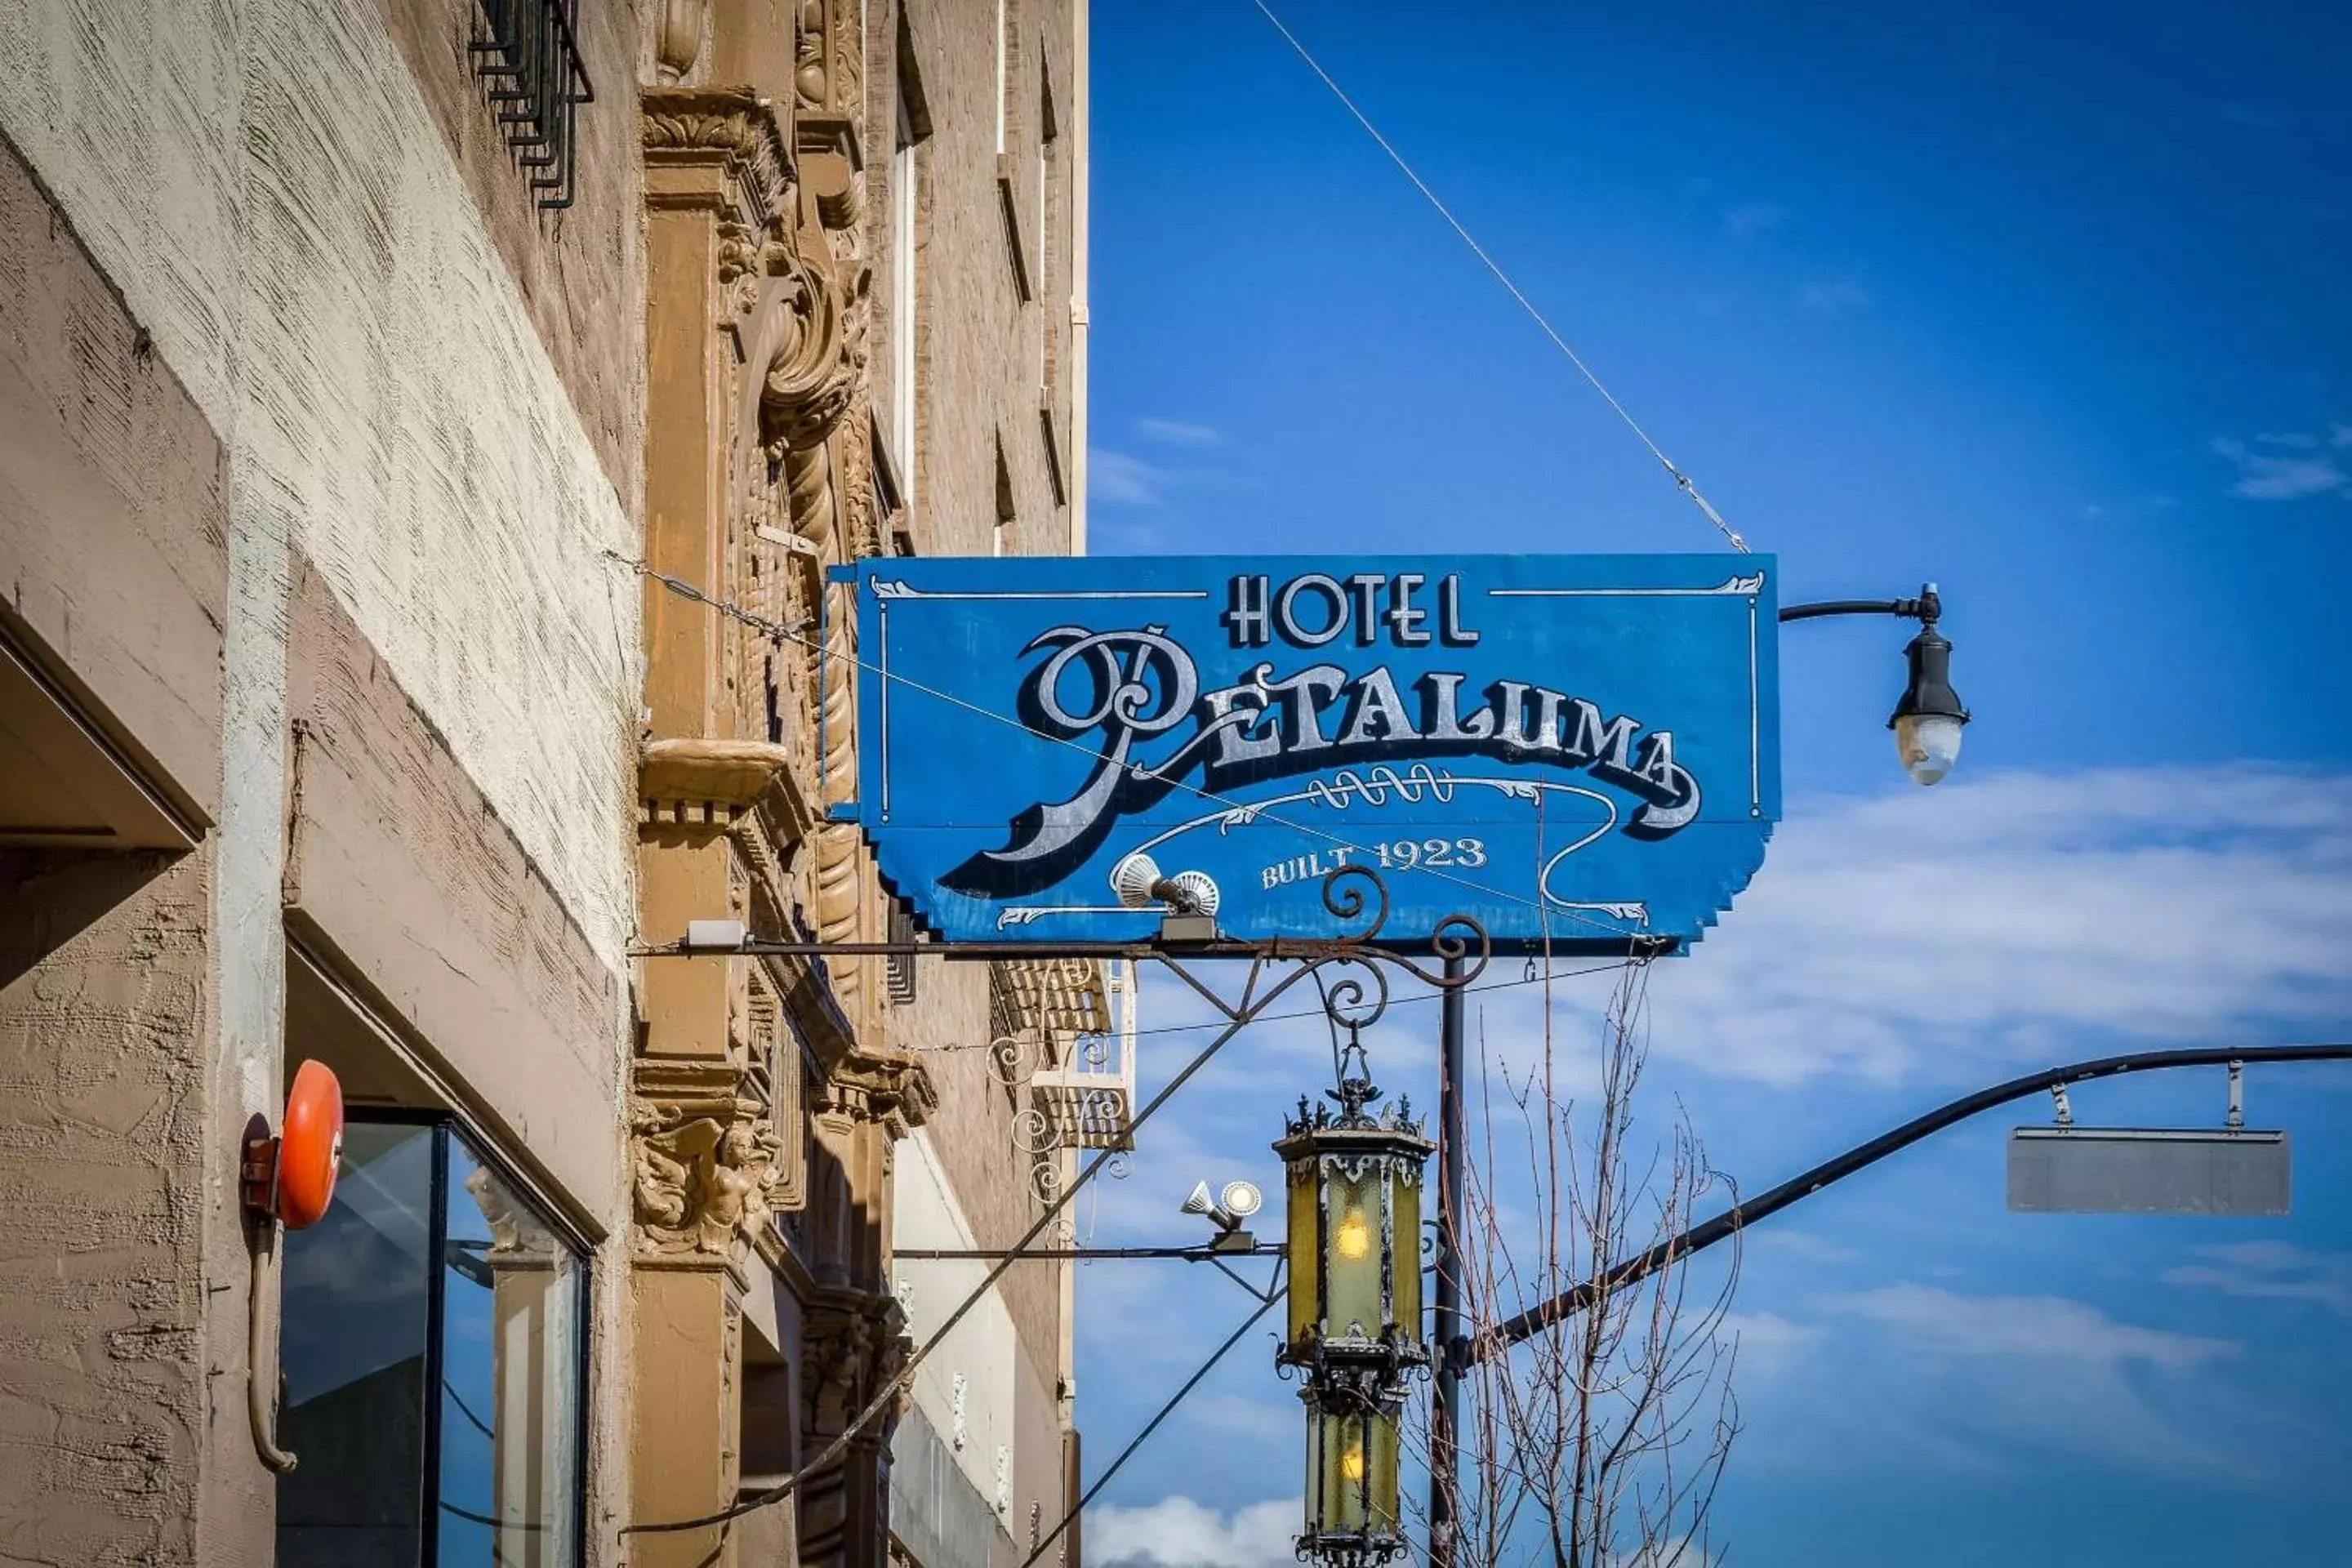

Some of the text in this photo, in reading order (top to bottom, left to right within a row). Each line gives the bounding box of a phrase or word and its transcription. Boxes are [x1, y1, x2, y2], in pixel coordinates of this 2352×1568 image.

[1228, 574, 1481, 645] HOTEL
[980, 624, 1701, 866] PETALUMA
[1261, 838, 1487, 891] BUILT 1923
